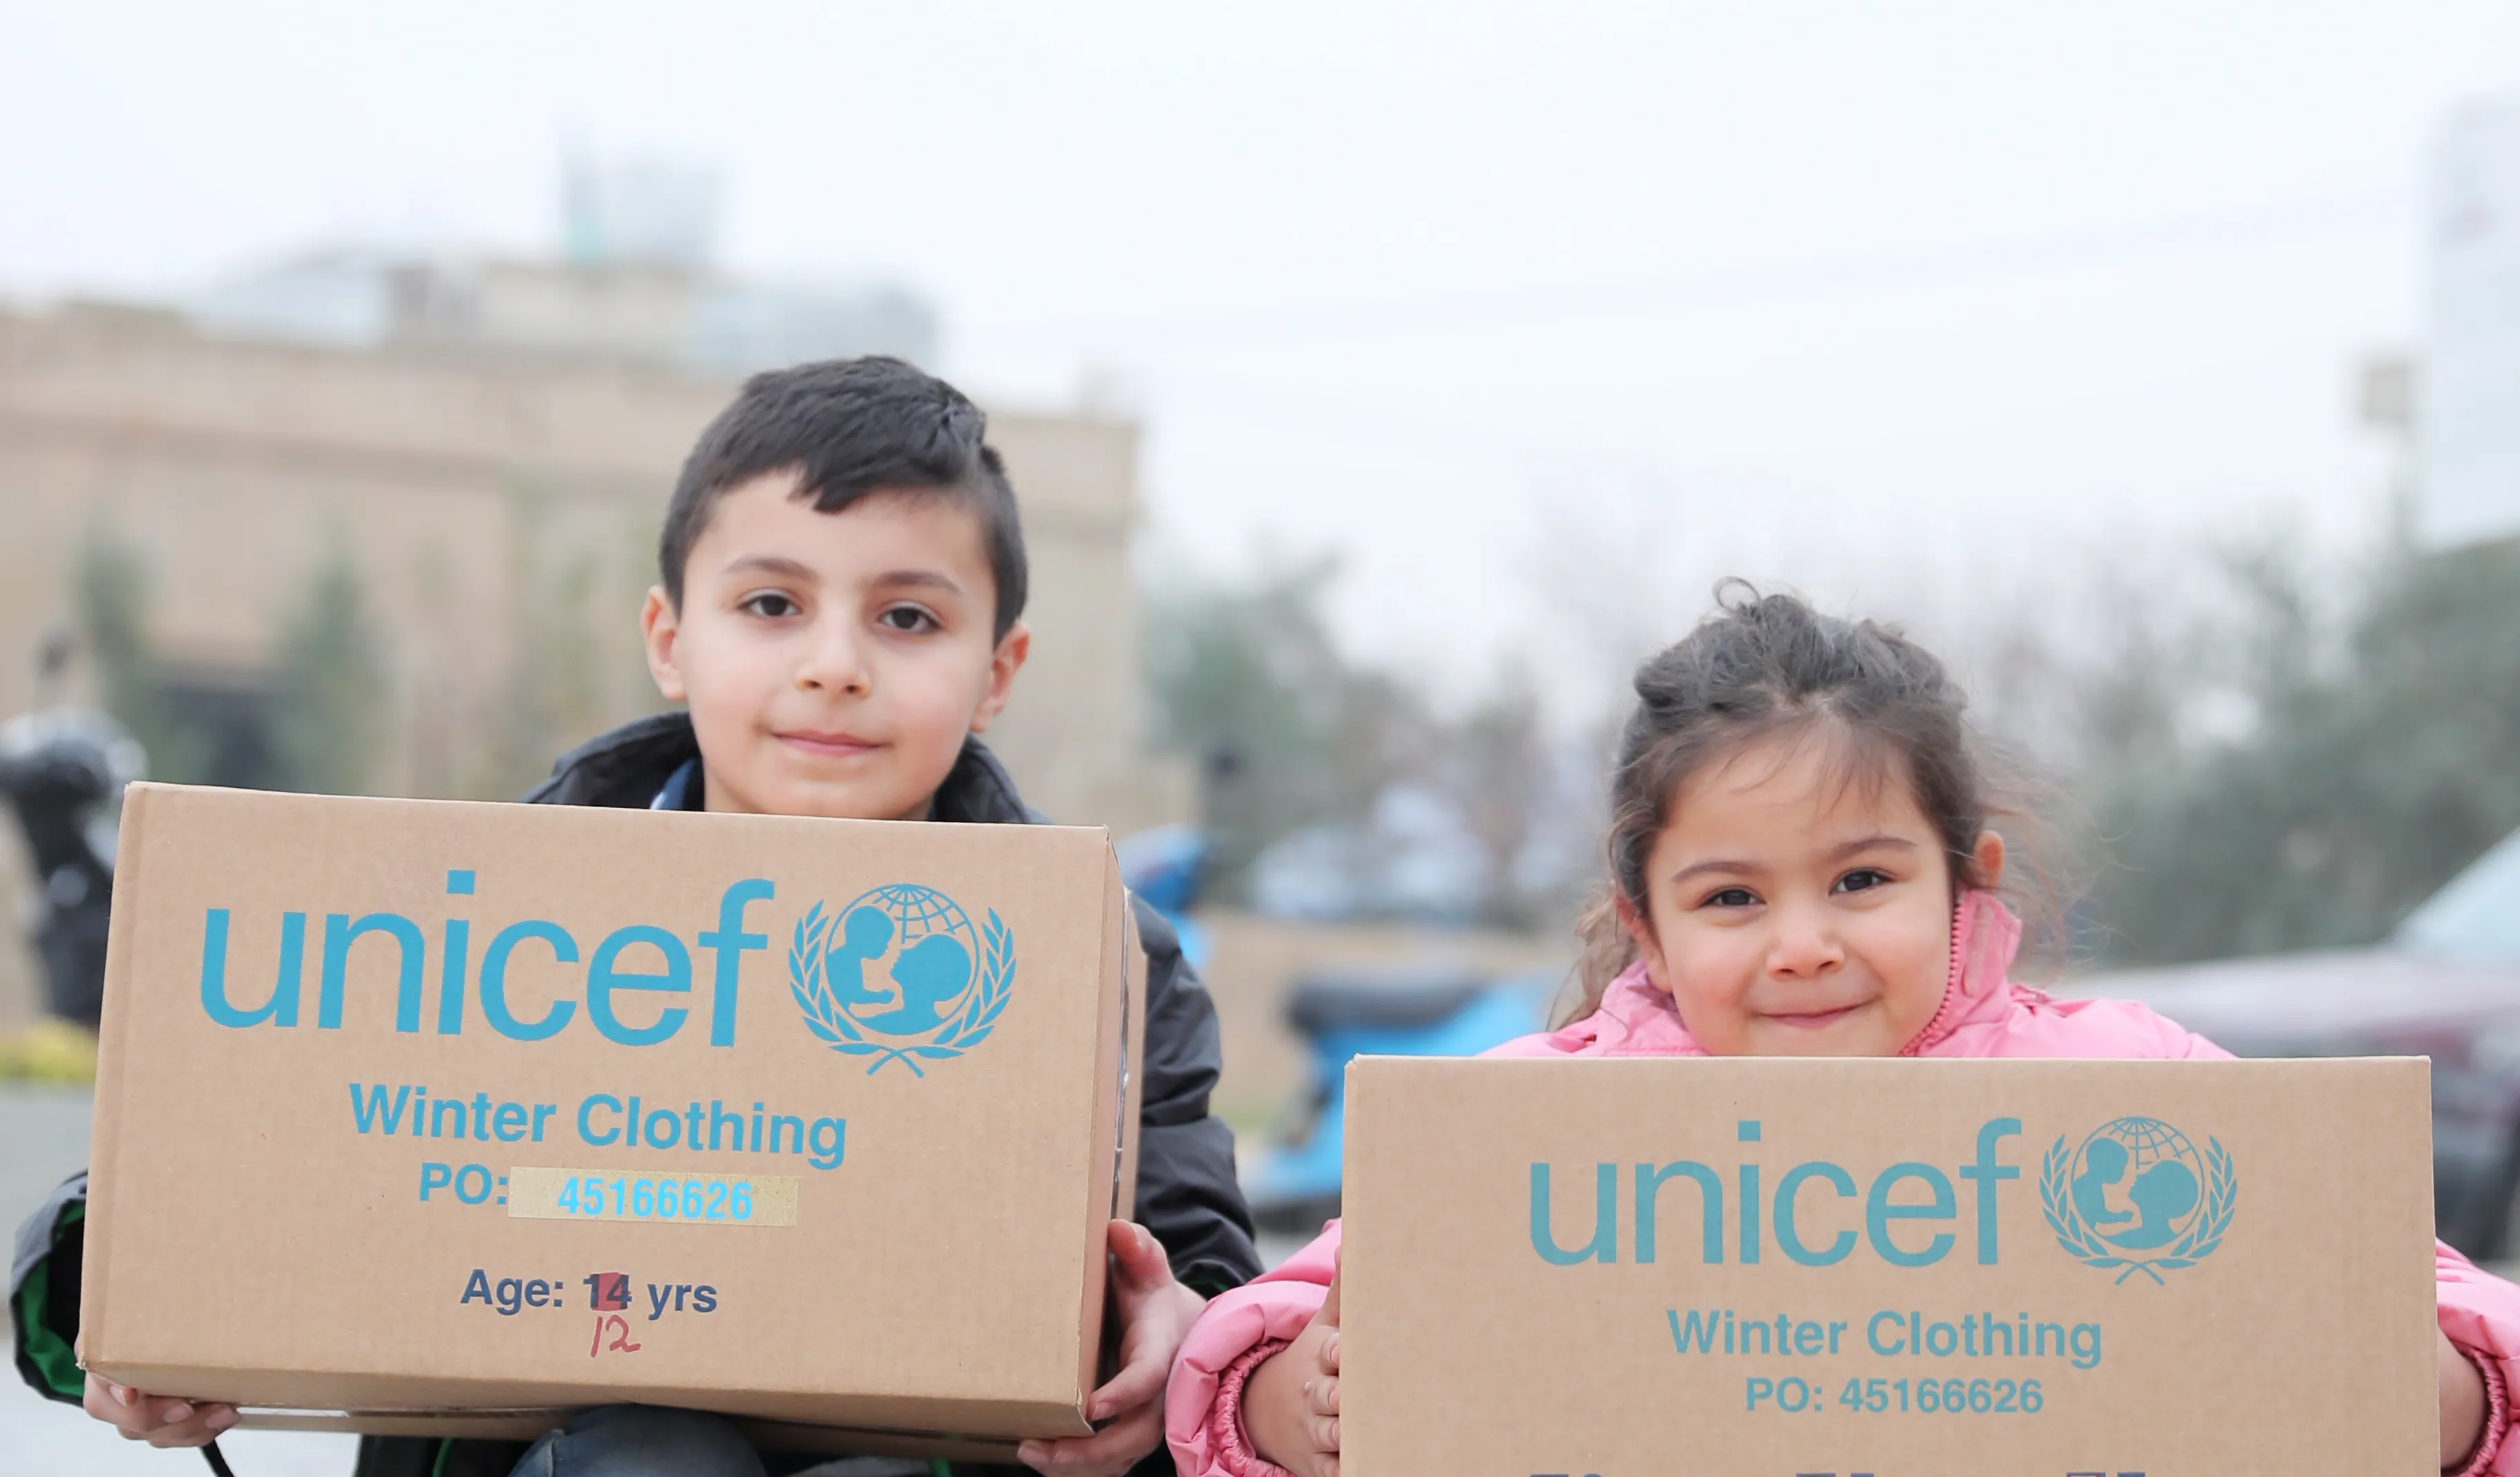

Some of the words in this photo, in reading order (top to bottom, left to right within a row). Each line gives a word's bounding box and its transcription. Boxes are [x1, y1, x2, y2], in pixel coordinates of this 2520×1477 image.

[200, 869, 775, 1047] unicef
[349, 1083, 556, 1142] Winter
[577, 1093, 846, 1169] Clothing
[419, 1162, 508, 1205] PO:
[558, 1176, 752, 1221] 45166626
[1531, 1118, 2021, 1267] unicef
[461, 1270, 563, 1315] Age:
[583, 1273, 632, 1310] 14
[647, 1283, 717, 1319] yrs
[590, 1314, 642, 1358] 12
[1668, 1310, 1847, 1355] Winter
[1868, 1310, 2101, 1368] Clothing
[1746, 1377, 1822, 1411] PO:
[1840, 1378, 2043, 1413] 45166626
